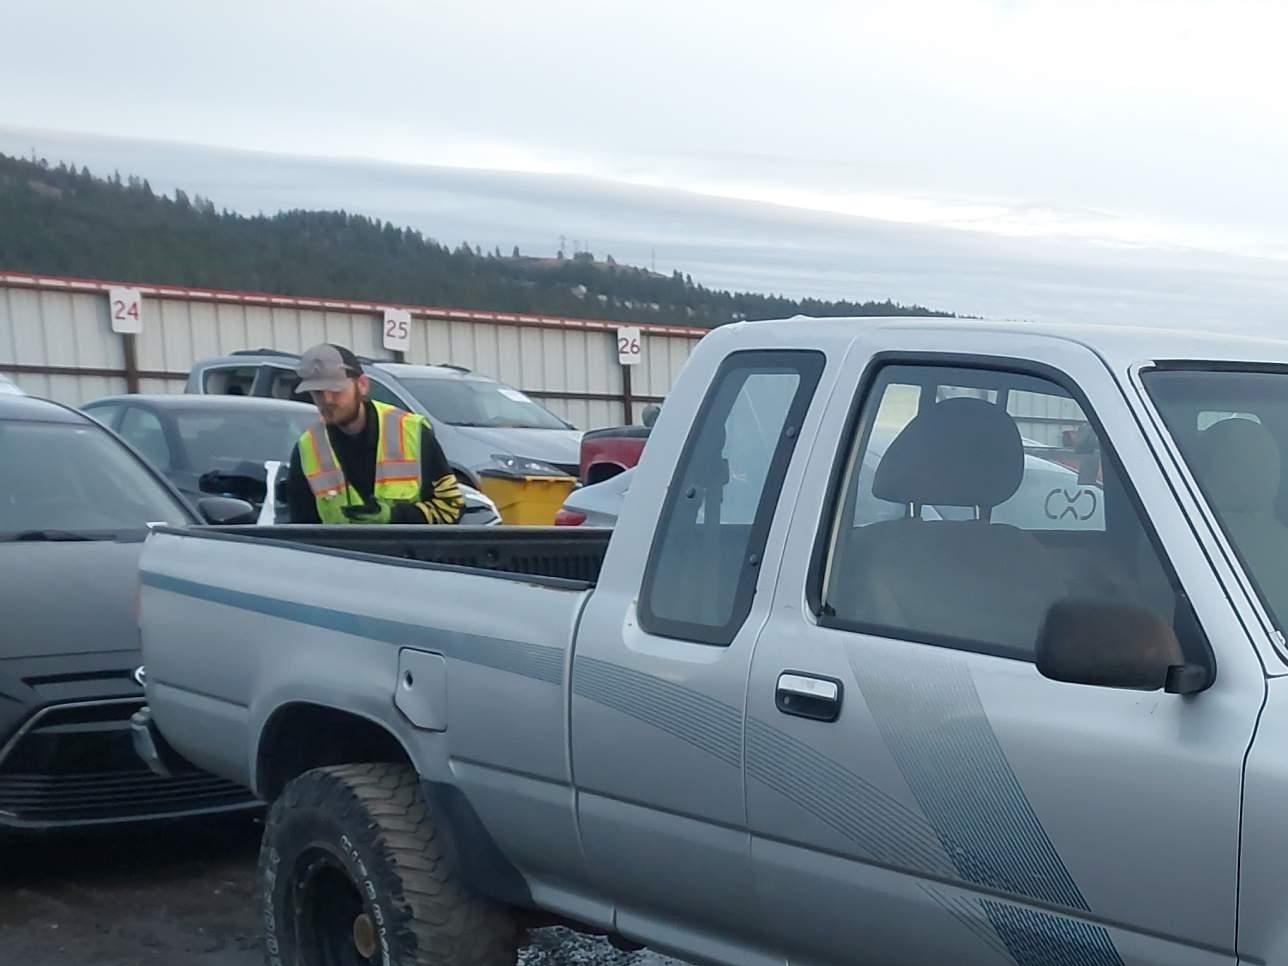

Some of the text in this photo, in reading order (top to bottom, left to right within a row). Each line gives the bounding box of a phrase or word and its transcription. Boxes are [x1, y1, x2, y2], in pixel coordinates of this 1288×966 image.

[113, 300, 139, 321] 24
[386, 319, 408, 340] 25
[619, 337, 641, 354] 26
